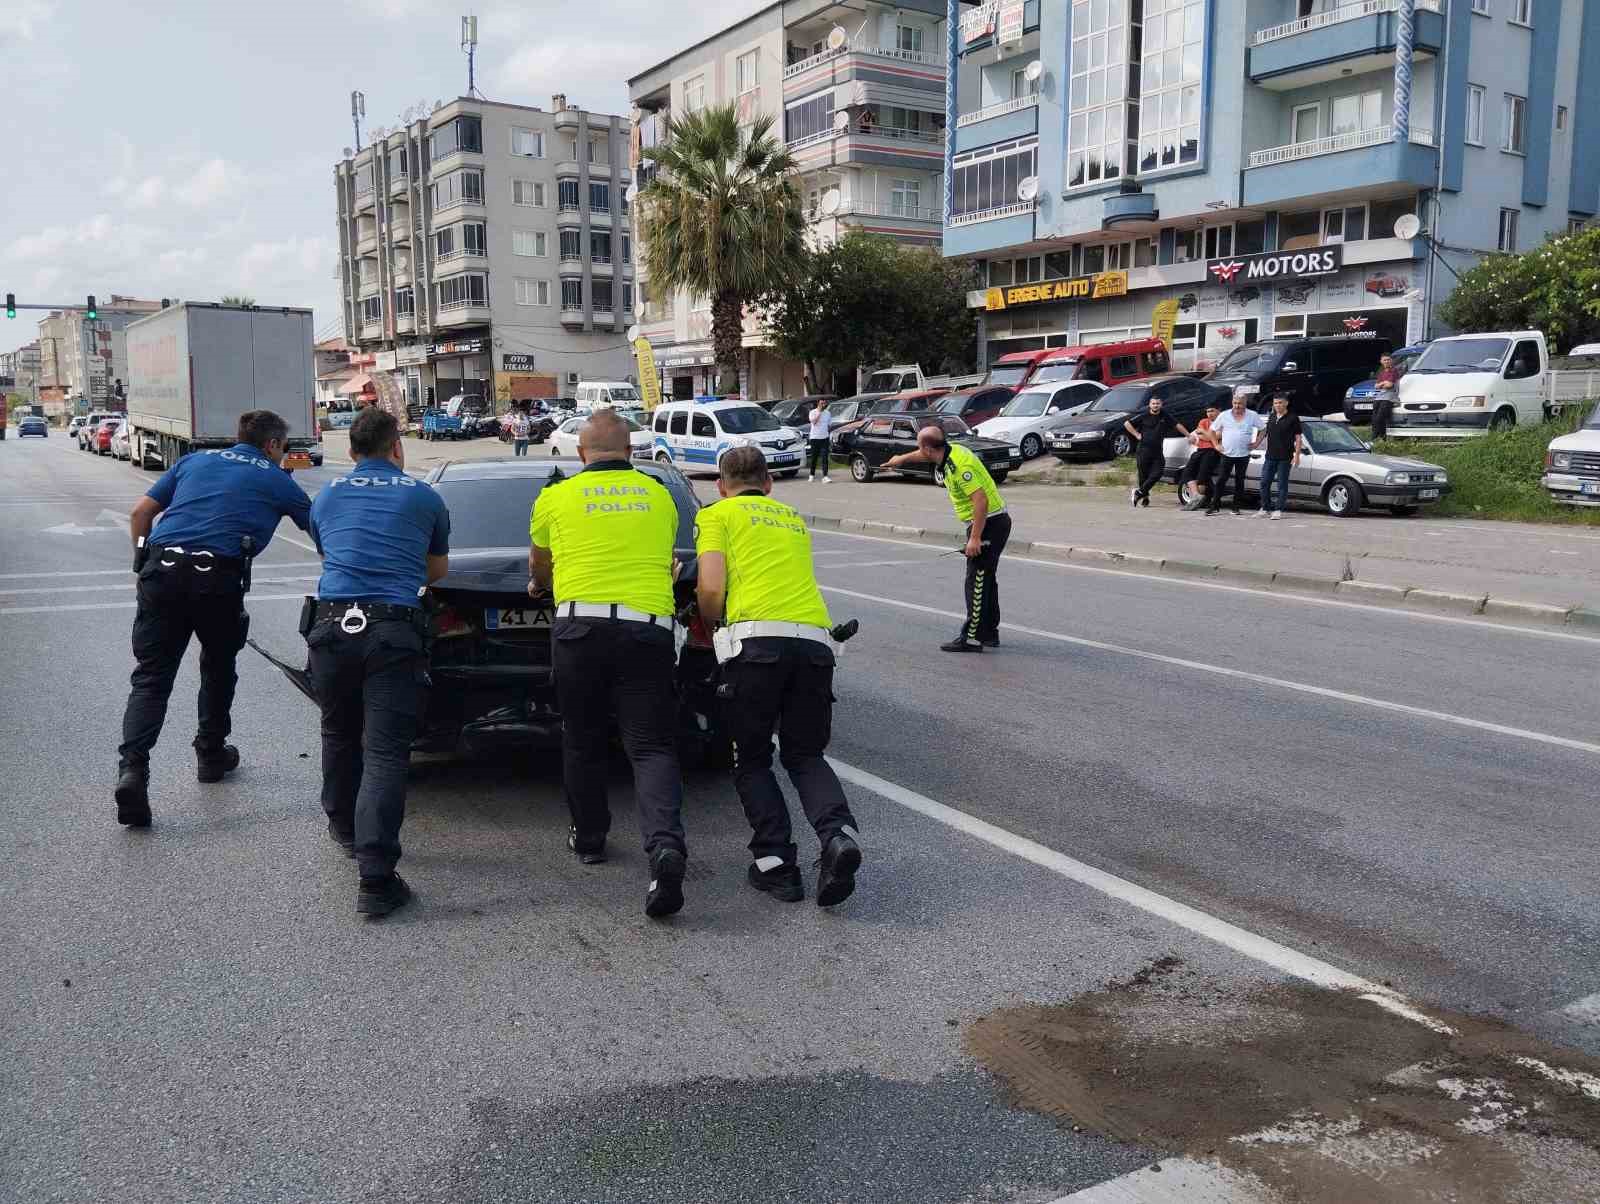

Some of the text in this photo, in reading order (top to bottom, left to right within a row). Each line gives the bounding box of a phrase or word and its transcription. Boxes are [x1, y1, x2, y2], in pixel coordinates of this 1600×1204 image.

[1247, 251, 1335, 279] MOTORS
[1007, 280, 1089, 305] ERGENE AUTO
[510, 355, 528, 363] OTO
[500, 607, 527, 625] 41
